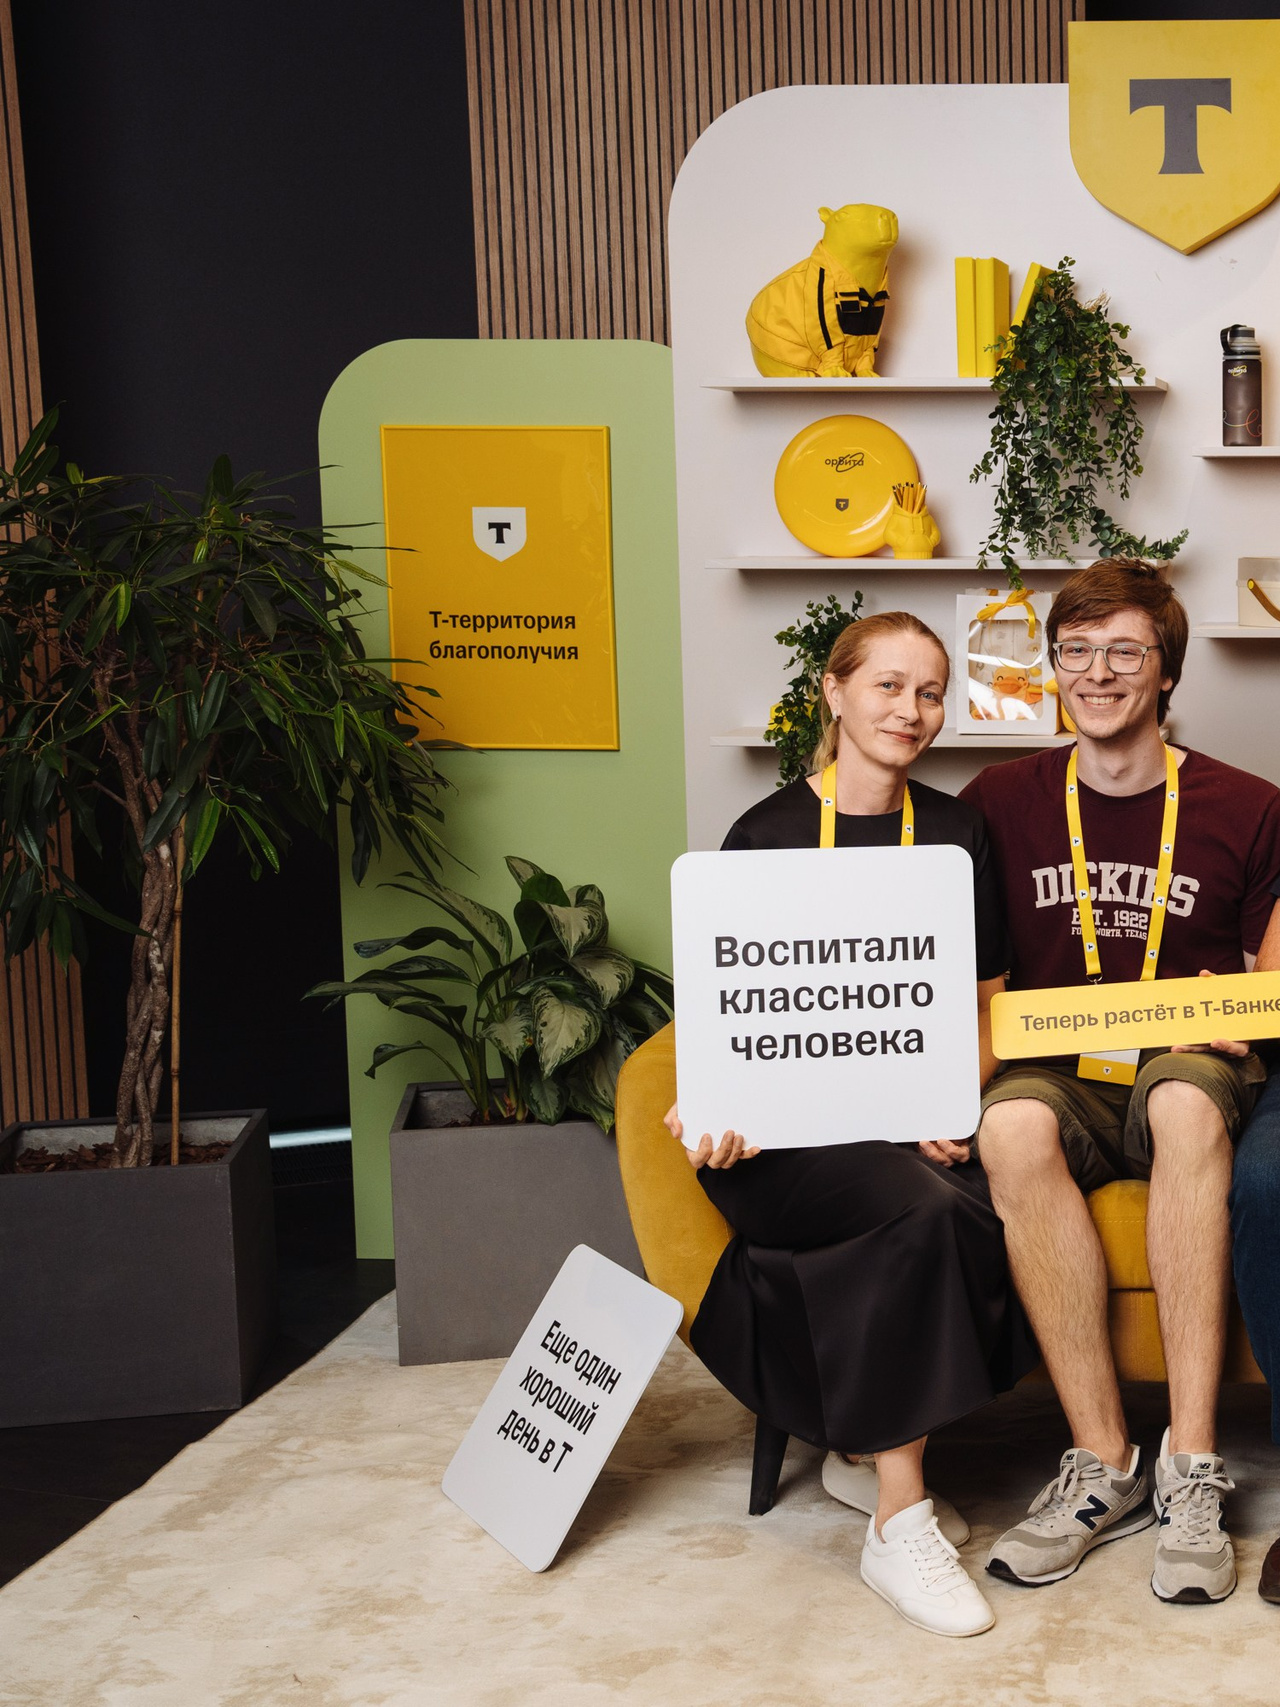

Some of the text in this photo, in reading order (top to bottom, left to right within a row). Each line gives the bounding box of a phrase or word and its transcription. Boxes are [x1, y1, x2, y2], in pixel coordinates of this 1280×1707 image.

[1129, 78, 1232, 174] Т
[487, 522, 512, 544] Т
[428, 610, 576, 634] Т-территория
[429, 639, 579, 664] благополучия
[1071, 907, 1149, 930] ET. 1922
[1125, 929, 1148, 940] TEXAS
[715, 935, 935, 968] Воспитали
[720, 981, 934, 1015] классного
[1020, 1013, 1099, 1032] Теперь
[1104, 1003, 1177, 1029] растёт
[1183, 1005, 1195, 1019] в
[731, 1028, 924, 1061] человека
[540, 1320, 622, 1395] Еще один
[518, 1365, 600, 1436] хороший
[496, 1409, 574, 1473] день в Т
